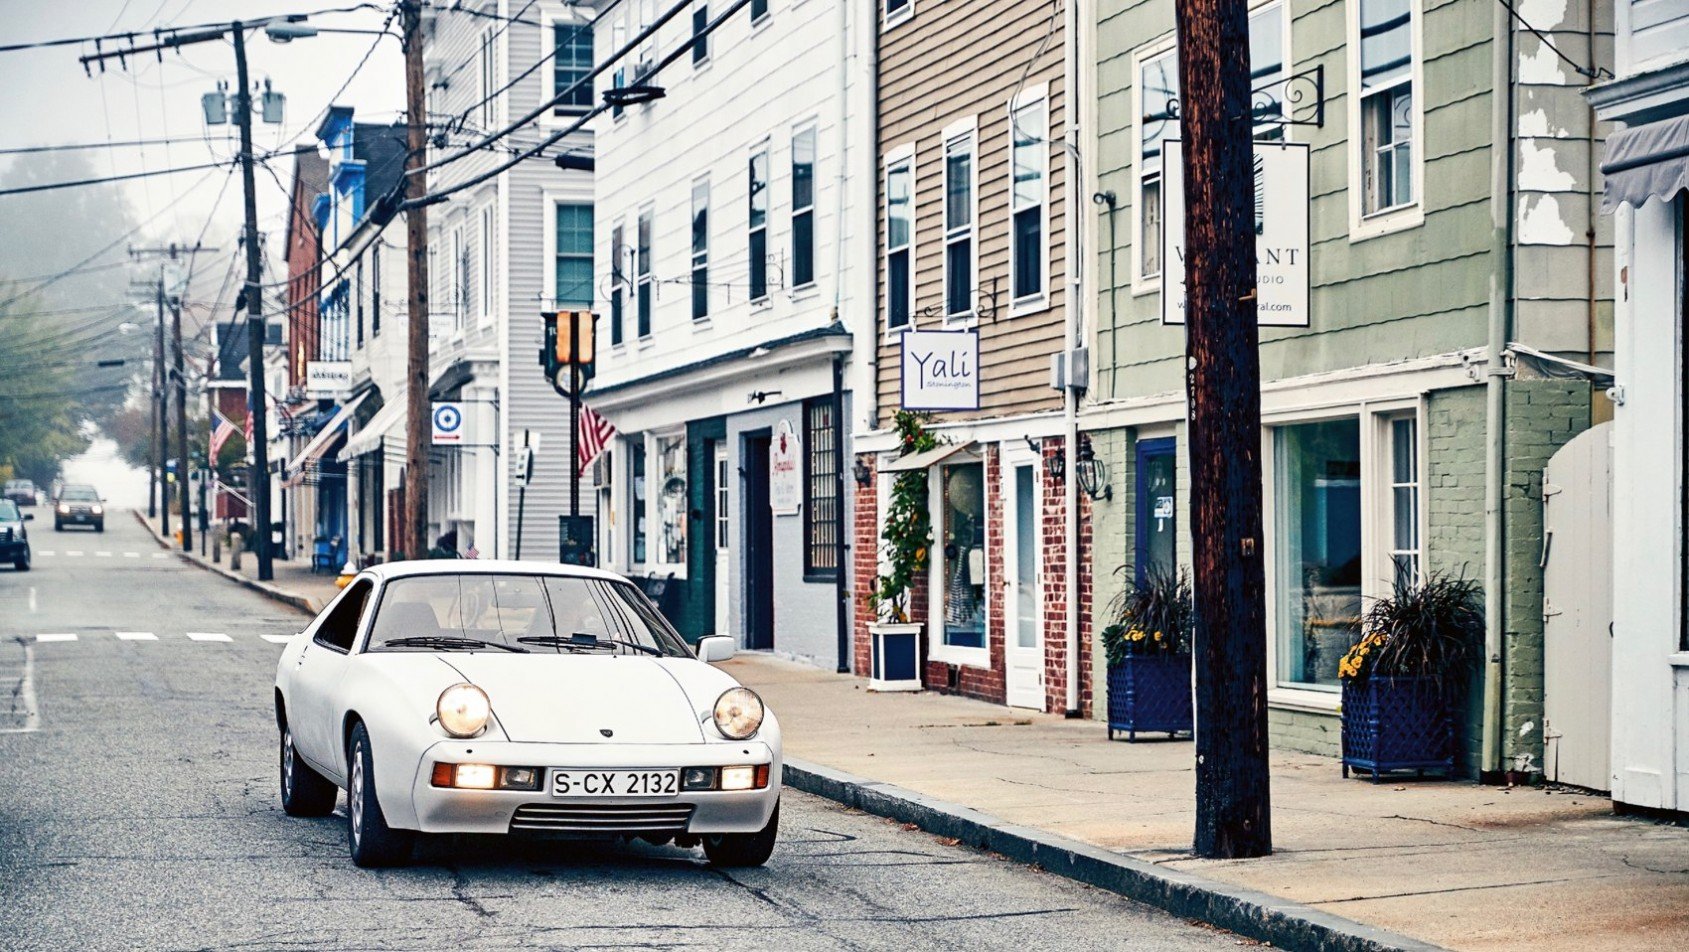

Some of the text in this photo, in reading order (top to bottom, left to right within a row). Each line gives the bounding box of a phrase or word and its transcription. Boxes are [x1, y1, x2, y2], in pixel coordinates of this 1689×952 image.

[910, 349, 971, 390] Yali
[555, 773, 676, 794] S-CX 2132
